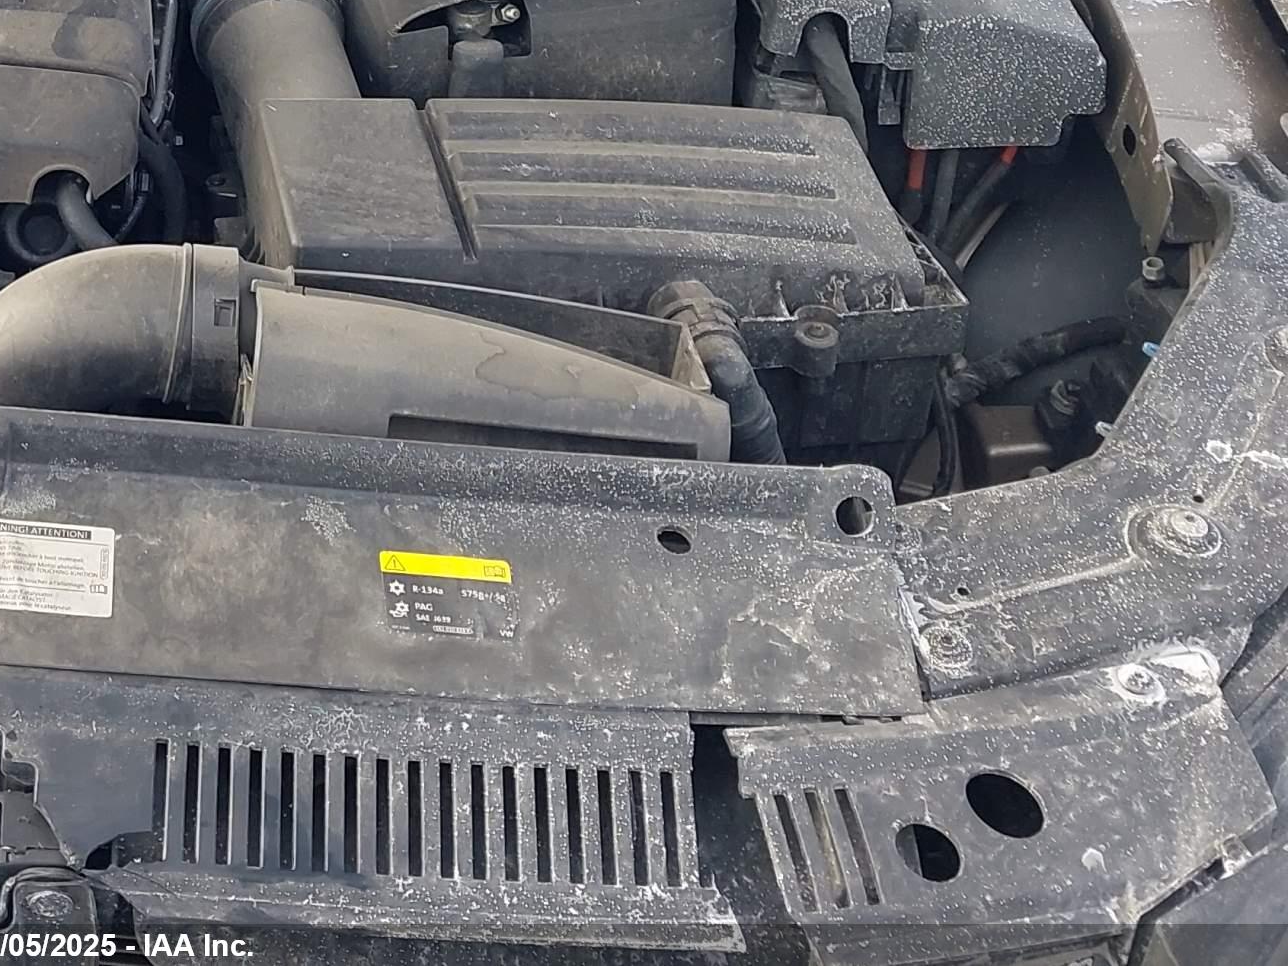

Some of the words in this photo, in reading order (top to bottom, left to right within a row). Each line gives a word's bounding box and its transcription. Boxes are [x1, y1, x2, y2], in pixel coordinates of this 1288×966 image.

[30, 526, 88, 538] ATTENTION!
[411, 585, 443, 594] R-134a
[414, 602, 433, 611] PAG
